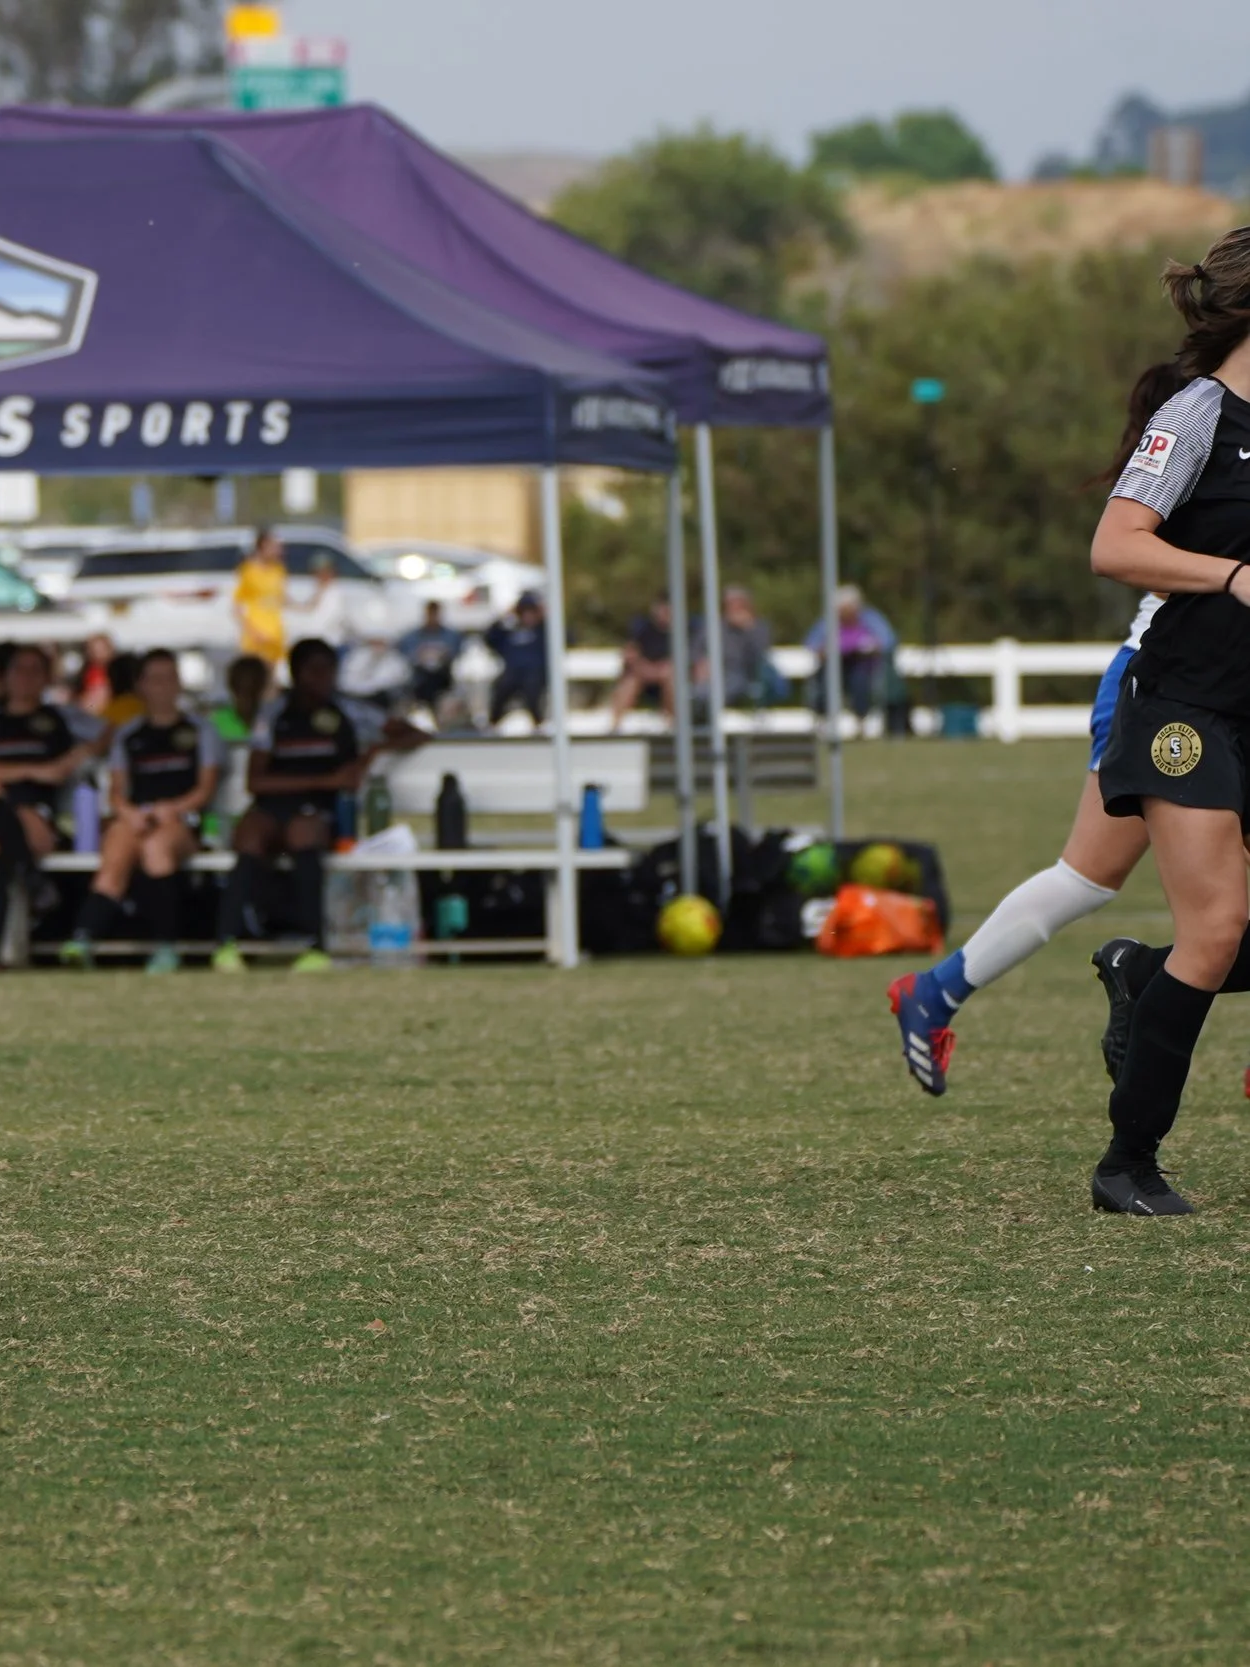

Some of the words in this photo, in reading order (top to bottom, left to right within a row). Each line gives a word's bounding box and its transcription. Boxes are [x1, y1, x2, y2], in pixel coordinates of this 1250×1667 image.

[59, 400, 291, 448] SPORTS
[1157, 724, 1176, 741] SOCAL
[1178, 724, 1197, 740] ELITE
[1154, 755, 1184, 775] FOOTBALL
[1184, 752, 1199, 770] CLUB
